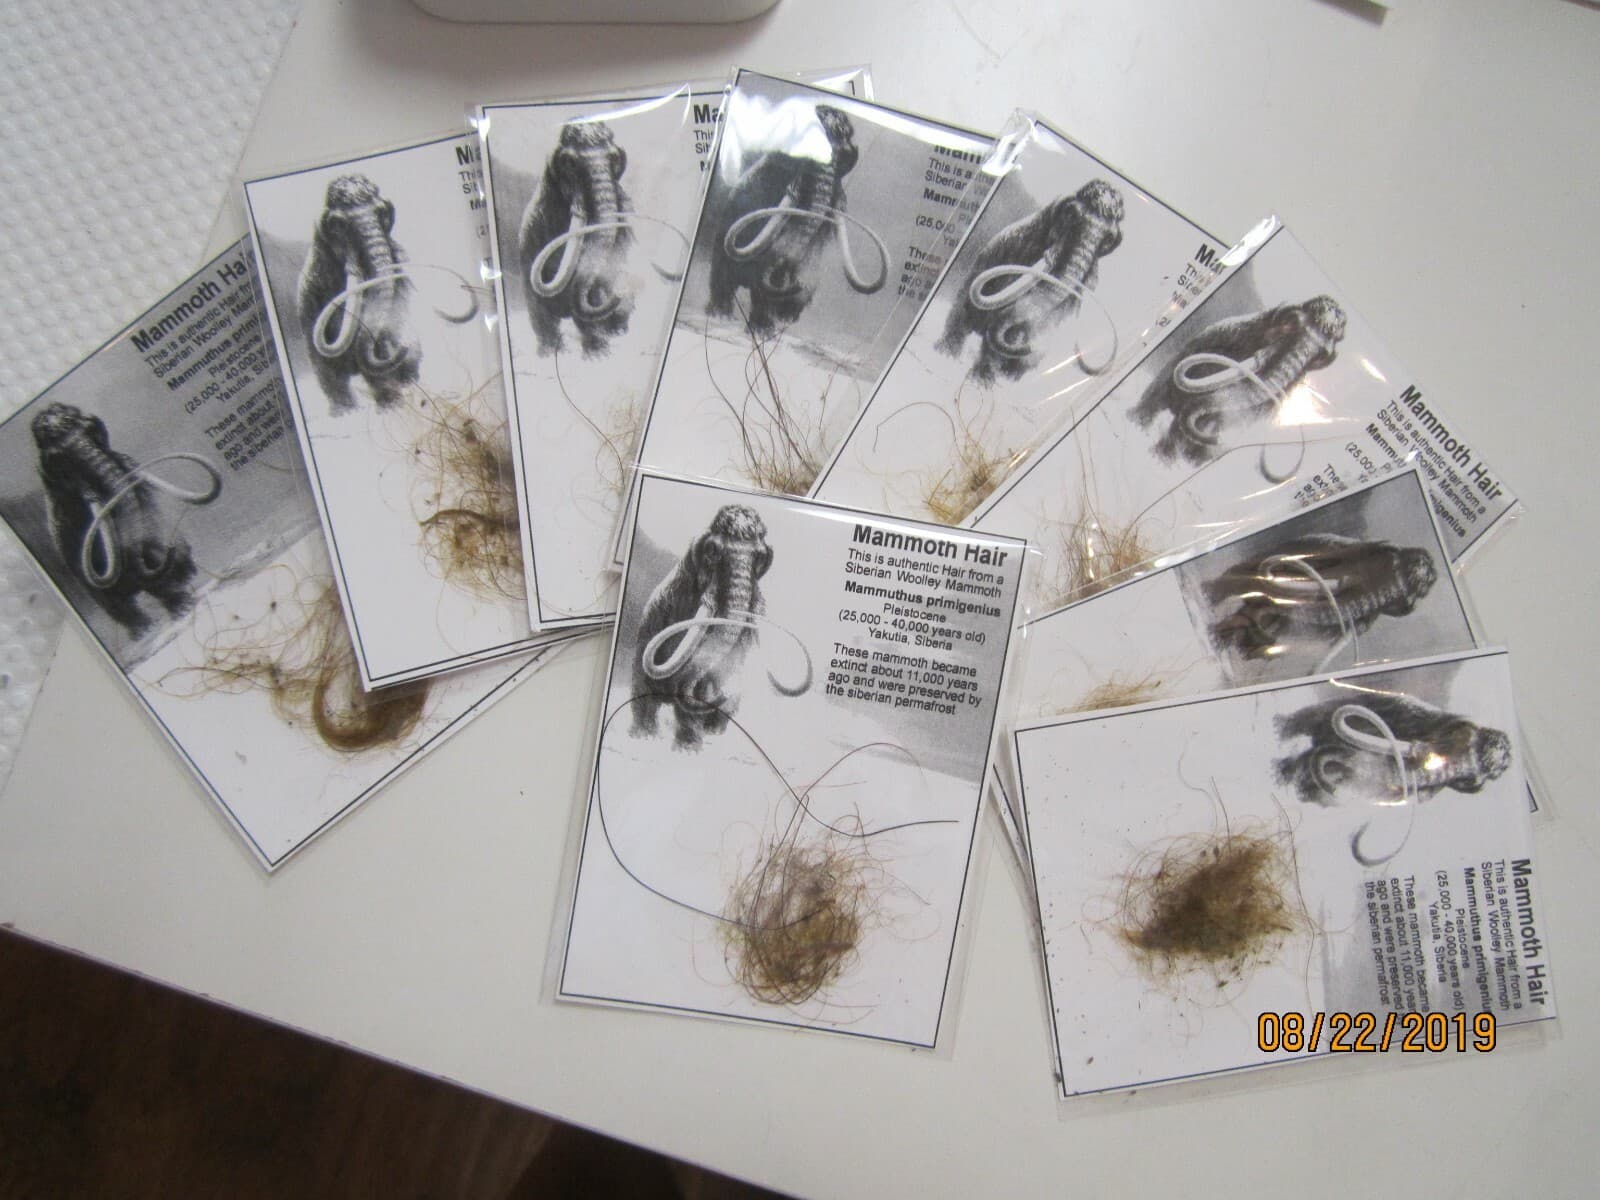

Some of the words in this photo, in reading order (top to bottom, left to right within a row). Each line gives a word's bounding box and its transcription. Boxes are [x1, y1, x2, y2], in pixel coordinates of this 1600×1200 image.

[929, 157, 951, 173] This
[953, 166, 963, 177] is
[131, 282, 221, 353] Mammoth
[144, 349, 169, 367] This
[167, 341, 178, 352] is
[178, 308, 221, 344] authentic
[218, 291, 243, 311] Hair
[153, 345, 195, 378] Siberian
[167, 339, 232, 390] Mammuthus
[205, 413, 237, 438] These
[216, 422, 248, 450] extinct
[247, 400, 275, 426] about
[1400, 385, 1470, 468] Mammoth
[1467, 462, 1502, 500] Hair
[224, 443, 243, 461] ago
[243, 426, 262, 445] and
[1387, 400, 1404, 422] This
[1402, 419, 1412, 431] is
[1410, 430, 1446, 469] authentic
[1444, 467, 1463, 487] Hair
[1461, 485, 1480, 508] from
[1477, 506, 1486, 515] a
[230, 456, 249, 471] the
[1377, 409, 1409, 446] Siberian
[1439, 479, 1477, 523] Mammoth
[853, 524, 957, 559] Mammoth
[964, 544, 1008, 567] Hair
[845, 562, 891, 579] Siberian
[898, 570, 941, 590] Woolley
[945, 579, 1001, 598] Mammoth
[849, 548, 872, 562] This
[875, 555, 884, 565] is
[887, 557, 939, 574] authentic
[942, 564, 966, 578] Hair
[969, 569, 994, 583] from
[996, 576, 1004, 585] a
[845, 581, 923, 604] Mammuthus
[926, 596, 1000, 617] primigenius
[884, 603, 947, 623] Pleistocene
[839, 609, 881, 625] (25,000
[892, 619, 929, 634] 40,000
[931, 627, 962, 639] years
[965, 631, 985, 645] old)
[869, 627, 909, 645] Yakutia,
[915, 635, 953, 651] Siberia
[831, 659, 868, 673] extinct
[871, 664, 903, 679] about
[908, 670, 944, 685] 11,000
[947, 678, 978, 691] years
[834, 643, 869, 659] These
[872, 652, 928, 669] mammoth
[932, 660, 977, 677] became
[826, 683, 844, 696] the
[847, 687, 892, 704] siberian
[895, 697, 956, 715] permafrost
[828, 672, 850, 686] ago
[853, 676, 875, 689] and
[878, 681, 906, 693] were
[908, 685, 965, 703] preserved
[969, 694, 982, 708] by
[1495, 859, 1505, 883] This
[1365, 882, 1376, 900] the
[1372, 880, 1388, 900] ago
[1391, 878, 1405, 914] extinct
[1405, 875, 1416, 910] These
[1436, 871, 1452, 910] (25,000
[1464, 867, 1481, 942] Mammuthus
[1498, 886, 1508, 895] is
[1368, 902, 1381, 944] siberian
[1376, 904, 1393, 924] and
[1430, 901, 1442, 943] Yakutia,
[1499, 898, 1514, 948] authentic
[1512, 859, 1542, 958] Mammoth
[1384, 926, 1395, 953] were
[1390, 916, 1409, 947] about
[1409, 913, 1425, 967] mammoth
[1444, 920, 1458, 957] 40,000
[1456, 908, 1472, 970] Pleistocene
[1481, 862, 1495, 906] Siberian
[1488, 910, 1502, 953] Woolley
[1495, 957, 1511, 1011] Mammoth
[1373, 948, 1391, 1006] permafrost
[1401, 950, 1415, 986] 11,000
[1434, 946, 1449, 984] Siberia
[1447, 959, 1460, 989] years
[1507, 950, 1518, 972] Hair
[1386, 956, 1405, 1010] preserved
[1416, 970, 1430, 1013] became
[1453, 991, 1465, 1011] old)
[1510, 974, 1521, 1000] from
[1526, 965, 1548, 1005] Hair
[1513, 1002, 1522, 1010] a
